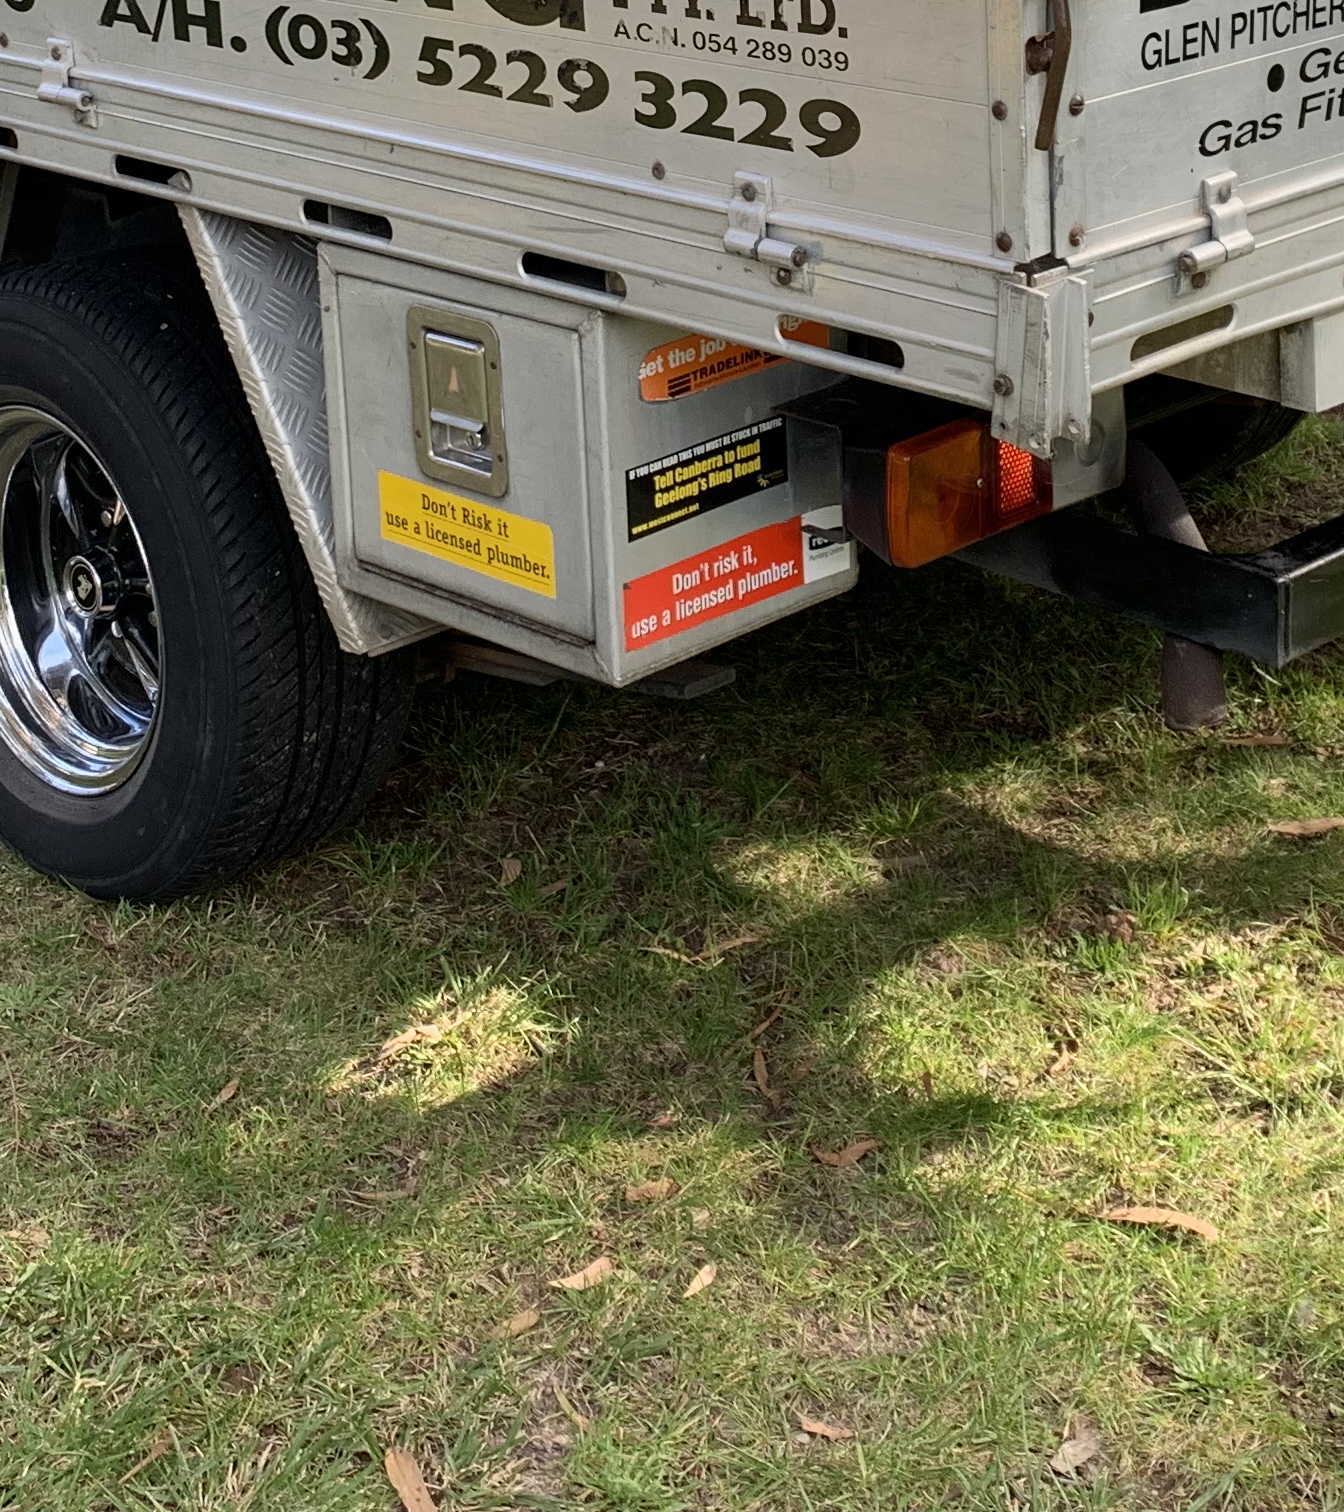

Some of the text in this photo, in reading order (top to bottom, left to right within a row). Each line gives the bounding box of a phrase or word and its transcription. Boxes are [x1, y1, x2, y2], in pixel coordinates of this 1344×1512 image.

[613, 18, 850, 73] A.C.N. 054 289 039
[1140, 17, 1222, 72] GLEN
[264, 4, 391, 81] (03)
[415, 35, 611, 114] 5229
[633, 69, 862, 159] 3229
[1197, 109, 1284, 158] Gas
[667, 346, 696, 369] the
[699, 338, 727, 363] job
[691, 349, 764, 382] TRADELINK
[628, 417, 783, 481] IF YOU CAN READ THIS YOU MUST BE STUCK IN TRAFFIC
[653, 438, 761, 491] Tell Canberra to fund
[655, 477, 708, 509] Geelong's
[708, 466, 733, 489] Ring
[733, 455, 762, 479] Road
[421, 493, 510, 539] Don't Risk it
[385, 512, 551, 580] use a licensed plumber.
[671, 544, 758, 595] Don't risk it,
[631, 559, 799, 639] use a licensed plumber.
